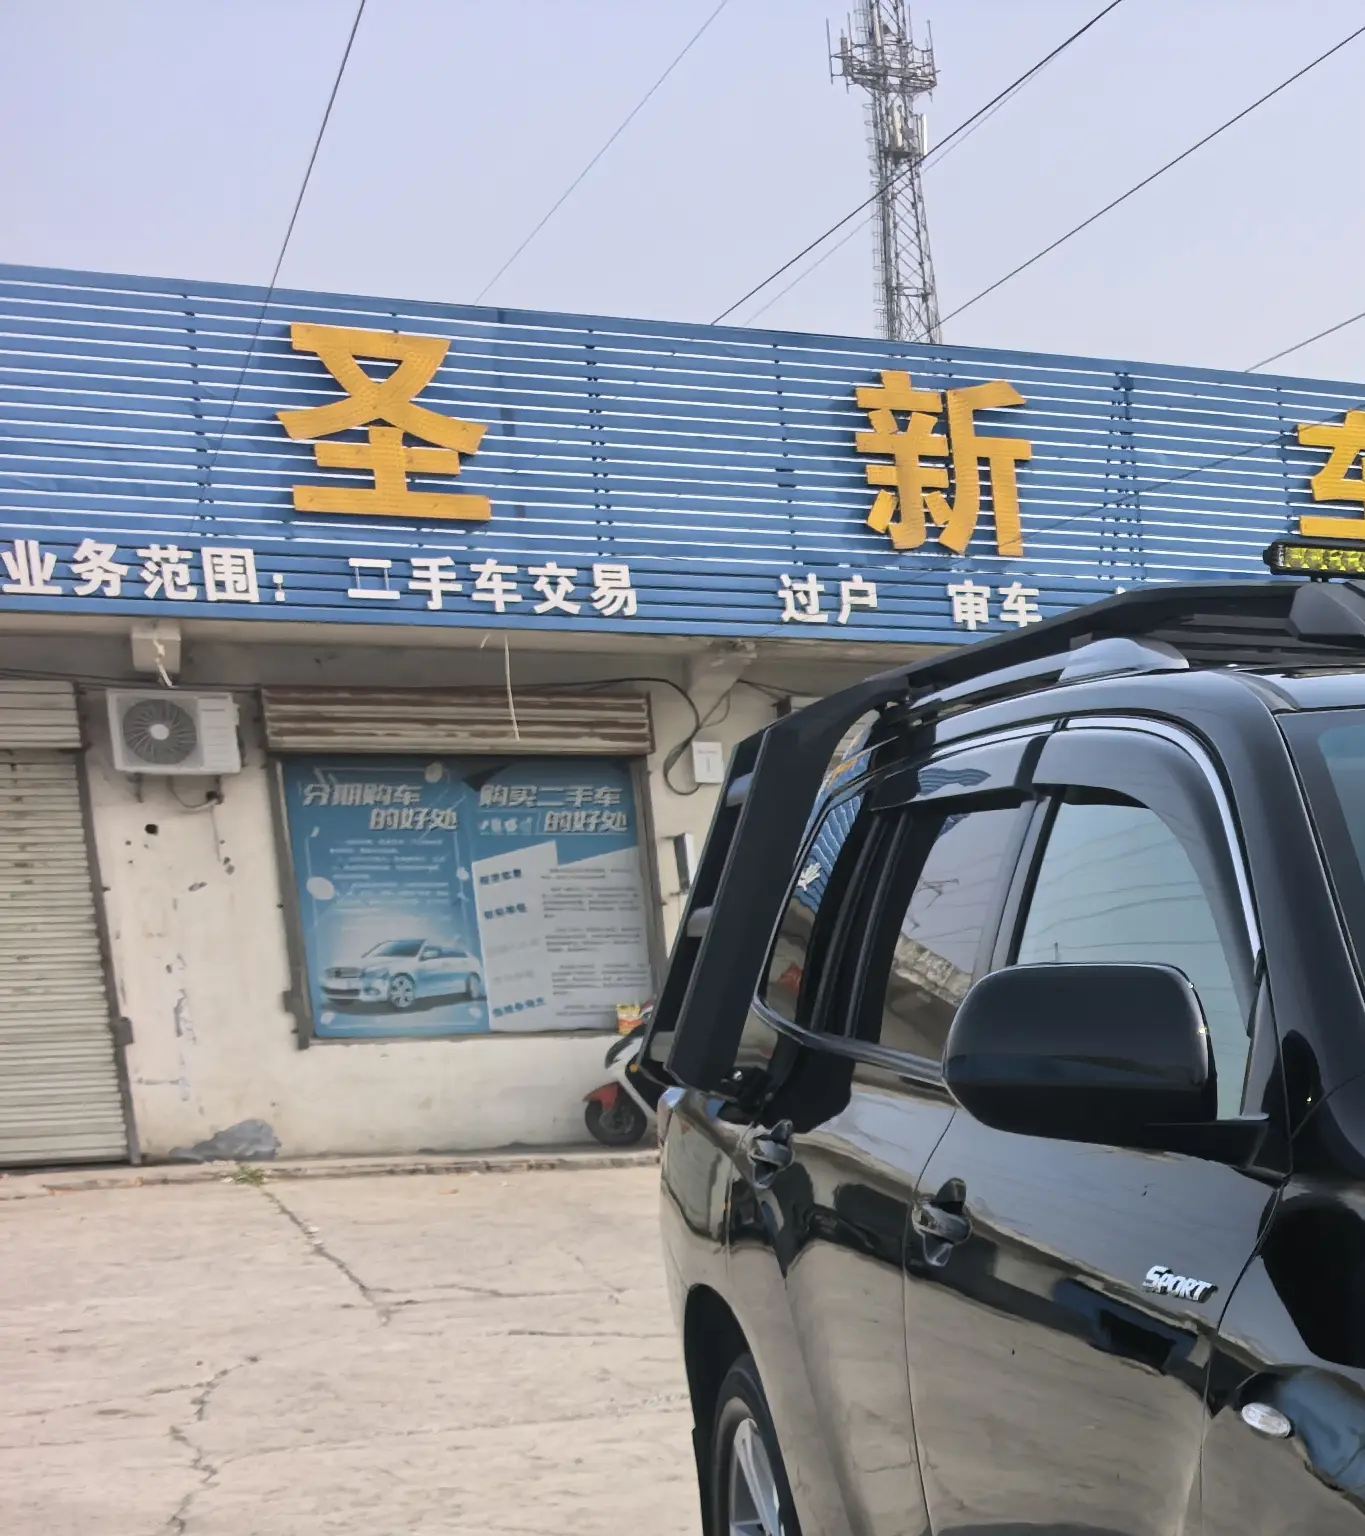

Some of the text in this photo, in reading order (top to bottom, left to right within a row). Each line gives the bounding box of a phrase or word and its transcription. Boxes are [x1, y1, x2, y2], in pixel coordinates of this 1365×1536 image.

[348, 557, 638, 618] 二手车交易
[777, 573, 878, 625] 过户
[947, 580, 1043, 631] 审车
[478, 784, 623, 808] 购买二手车
[370, 807, 458, 831] 的好处
[544, 810, 628, 832] 的好处
[1142, 1266, 1215, 1302] SPORT
